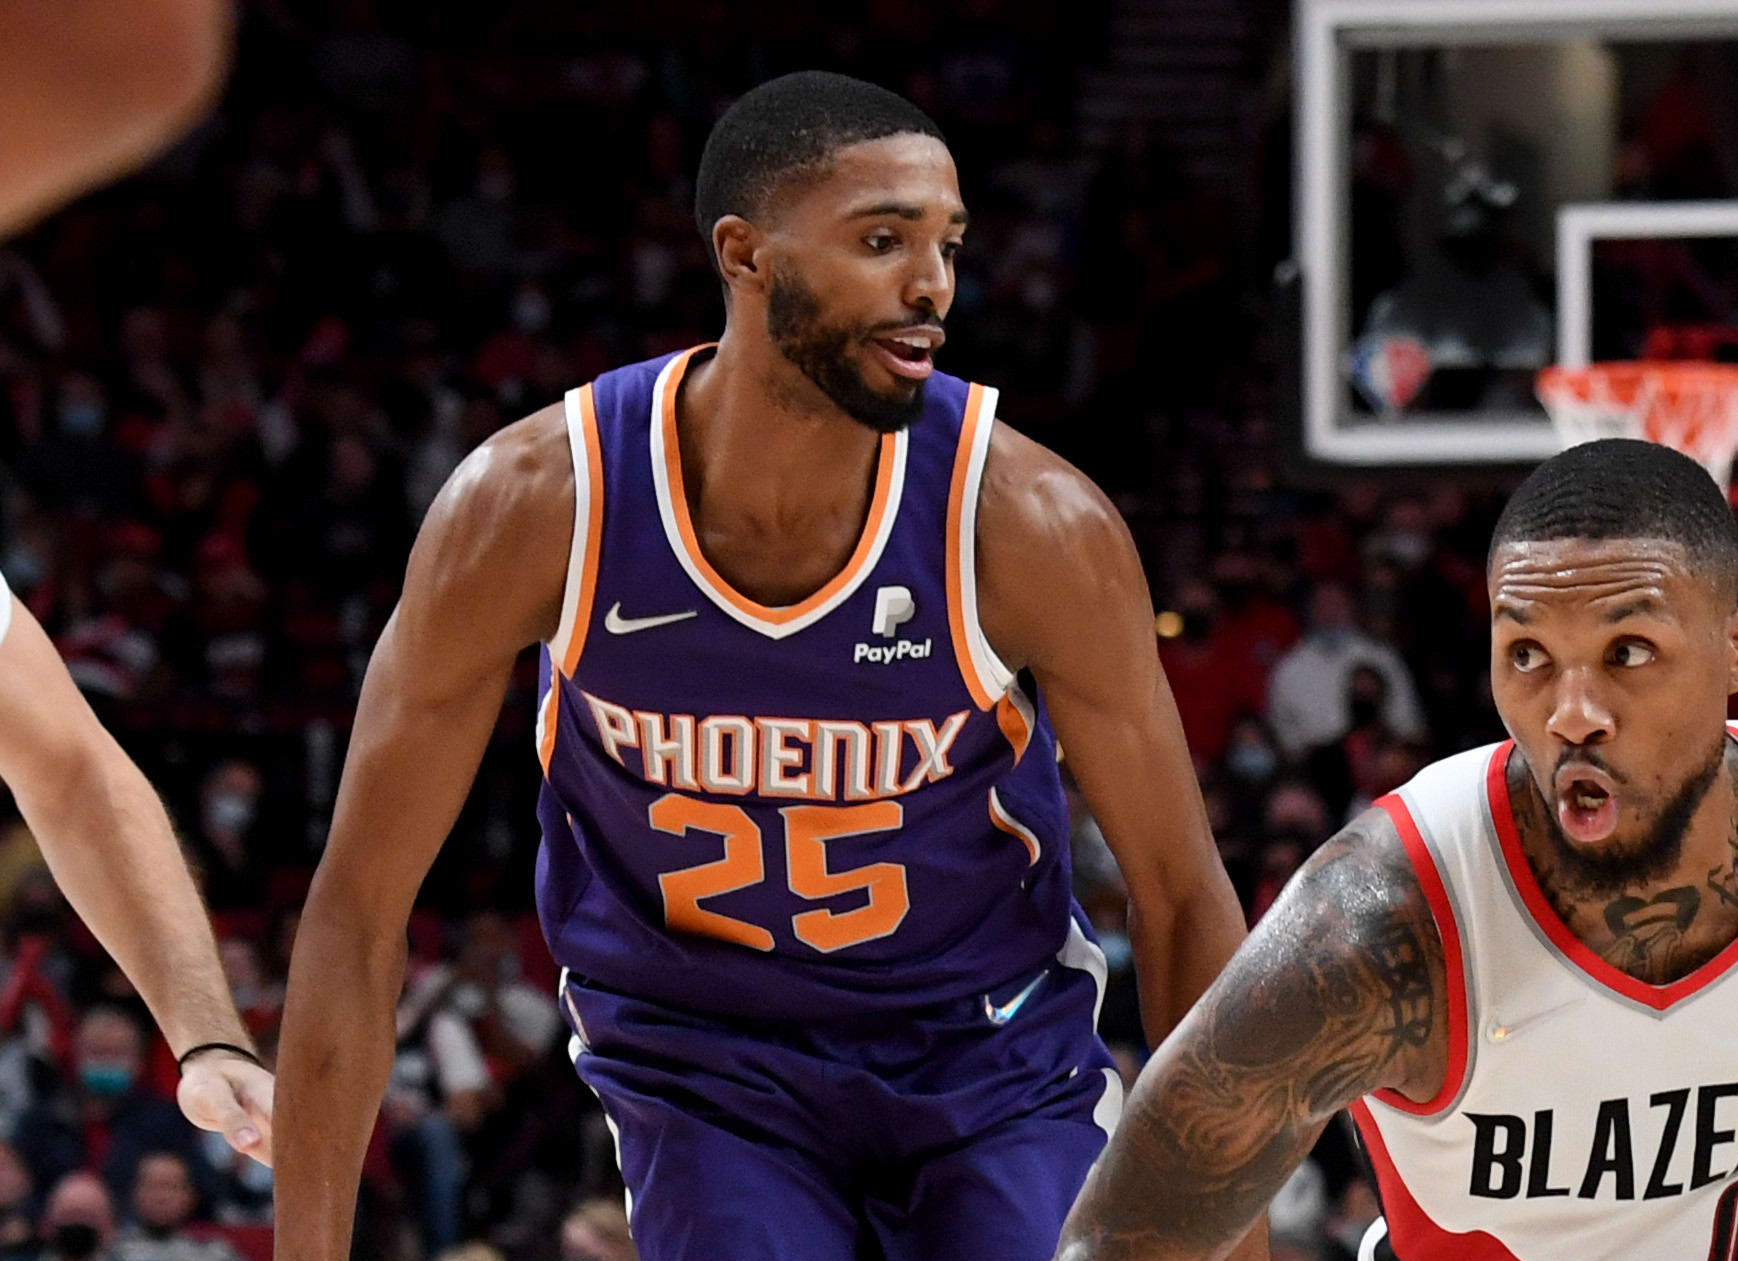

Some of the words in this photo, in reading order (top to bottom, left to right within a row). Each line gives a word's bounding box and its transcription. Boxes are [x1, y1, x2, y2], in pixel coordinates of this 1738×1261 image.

[853, 638, 932, 664] PayPal
[581, 690, 971, 801] PHOENIX
[648, 793, 910, 953] 25
